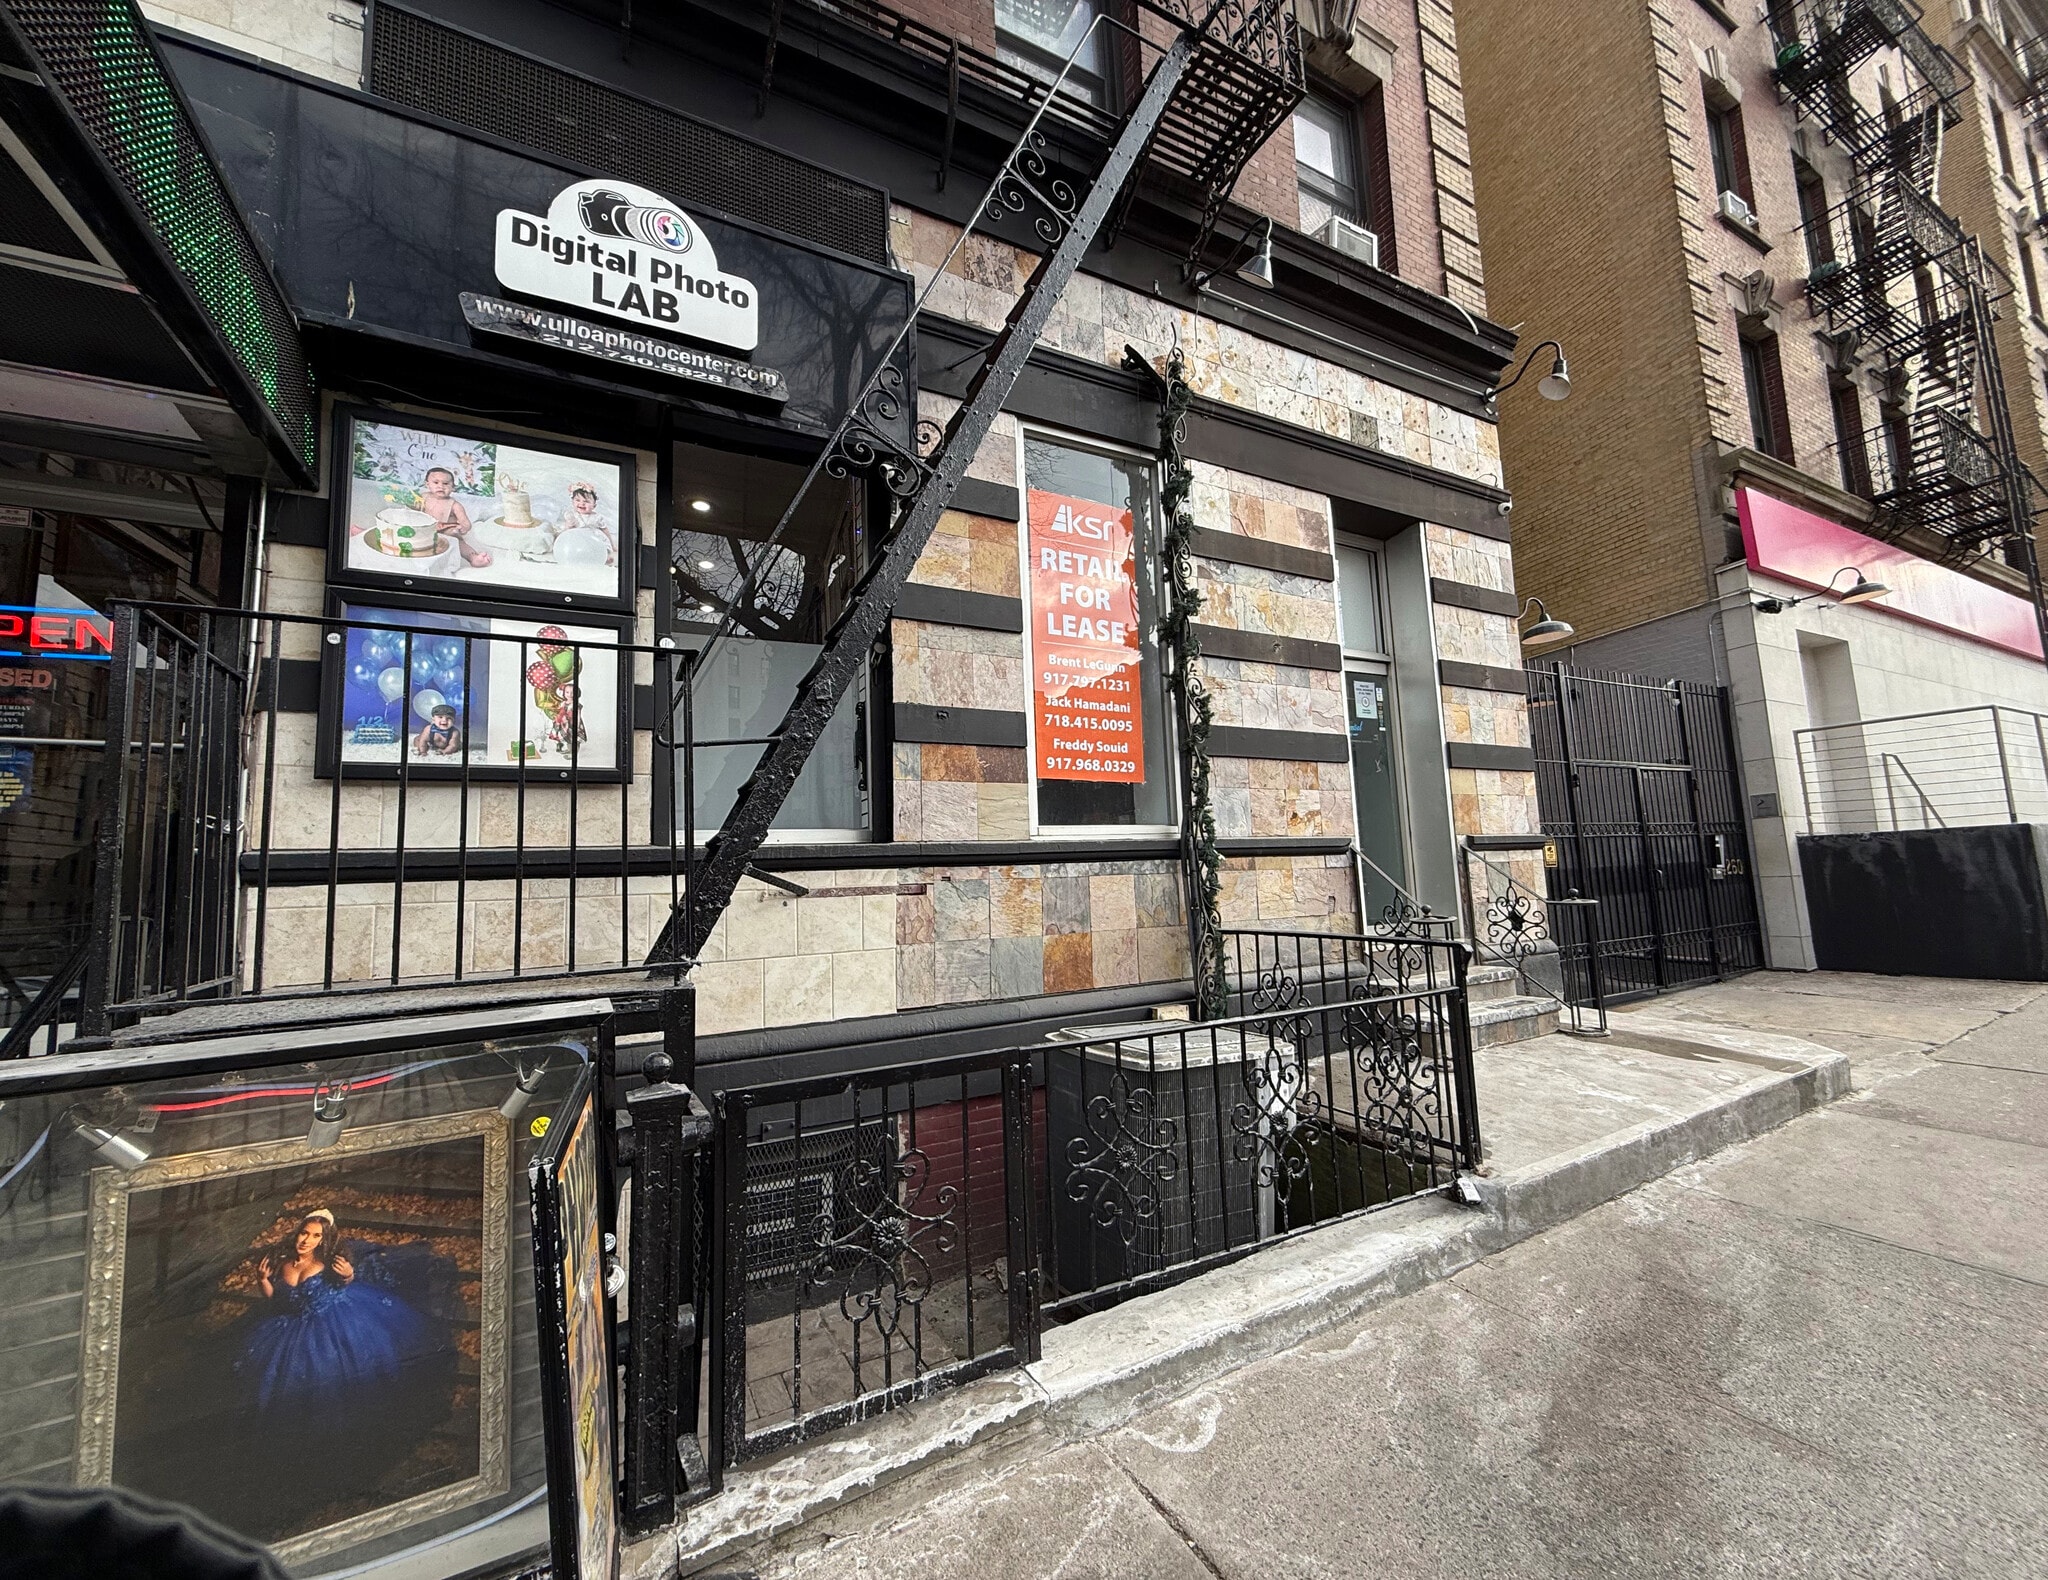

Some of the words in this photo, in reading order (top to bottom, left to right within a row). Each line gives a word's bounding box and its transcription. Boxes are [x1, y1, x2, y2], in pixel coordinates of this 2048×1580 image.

[511, 216, 637, 278] Digital
[650, 257, 750, 309] Photo
[592, 271, 680, 324] LAB
[475, 298, 777, 387] www.ulloaphotocenter.com
[543, 332, 724, 384] 212.740.5828
[1040, 547, 1127, 583] RETAIL
[1060, 582, 1111, 612] FOR
[1047, 612, 1125, 645] LEASE
[1048, 653, 1081, 668] Brent
[1043, 672, 1131, 693] 917.797.1231
[1045, 695, 1072, 708] Jack
[1074, 698, 1131, 713] Hamadani
[1044, 713, 1133, 732] 718.415.0095
[1053, 738, 1095, 754] Freddy
[1096, 740, 1128, 754] Souid
[1046, 756, 1136, 773] 917.968.0329
